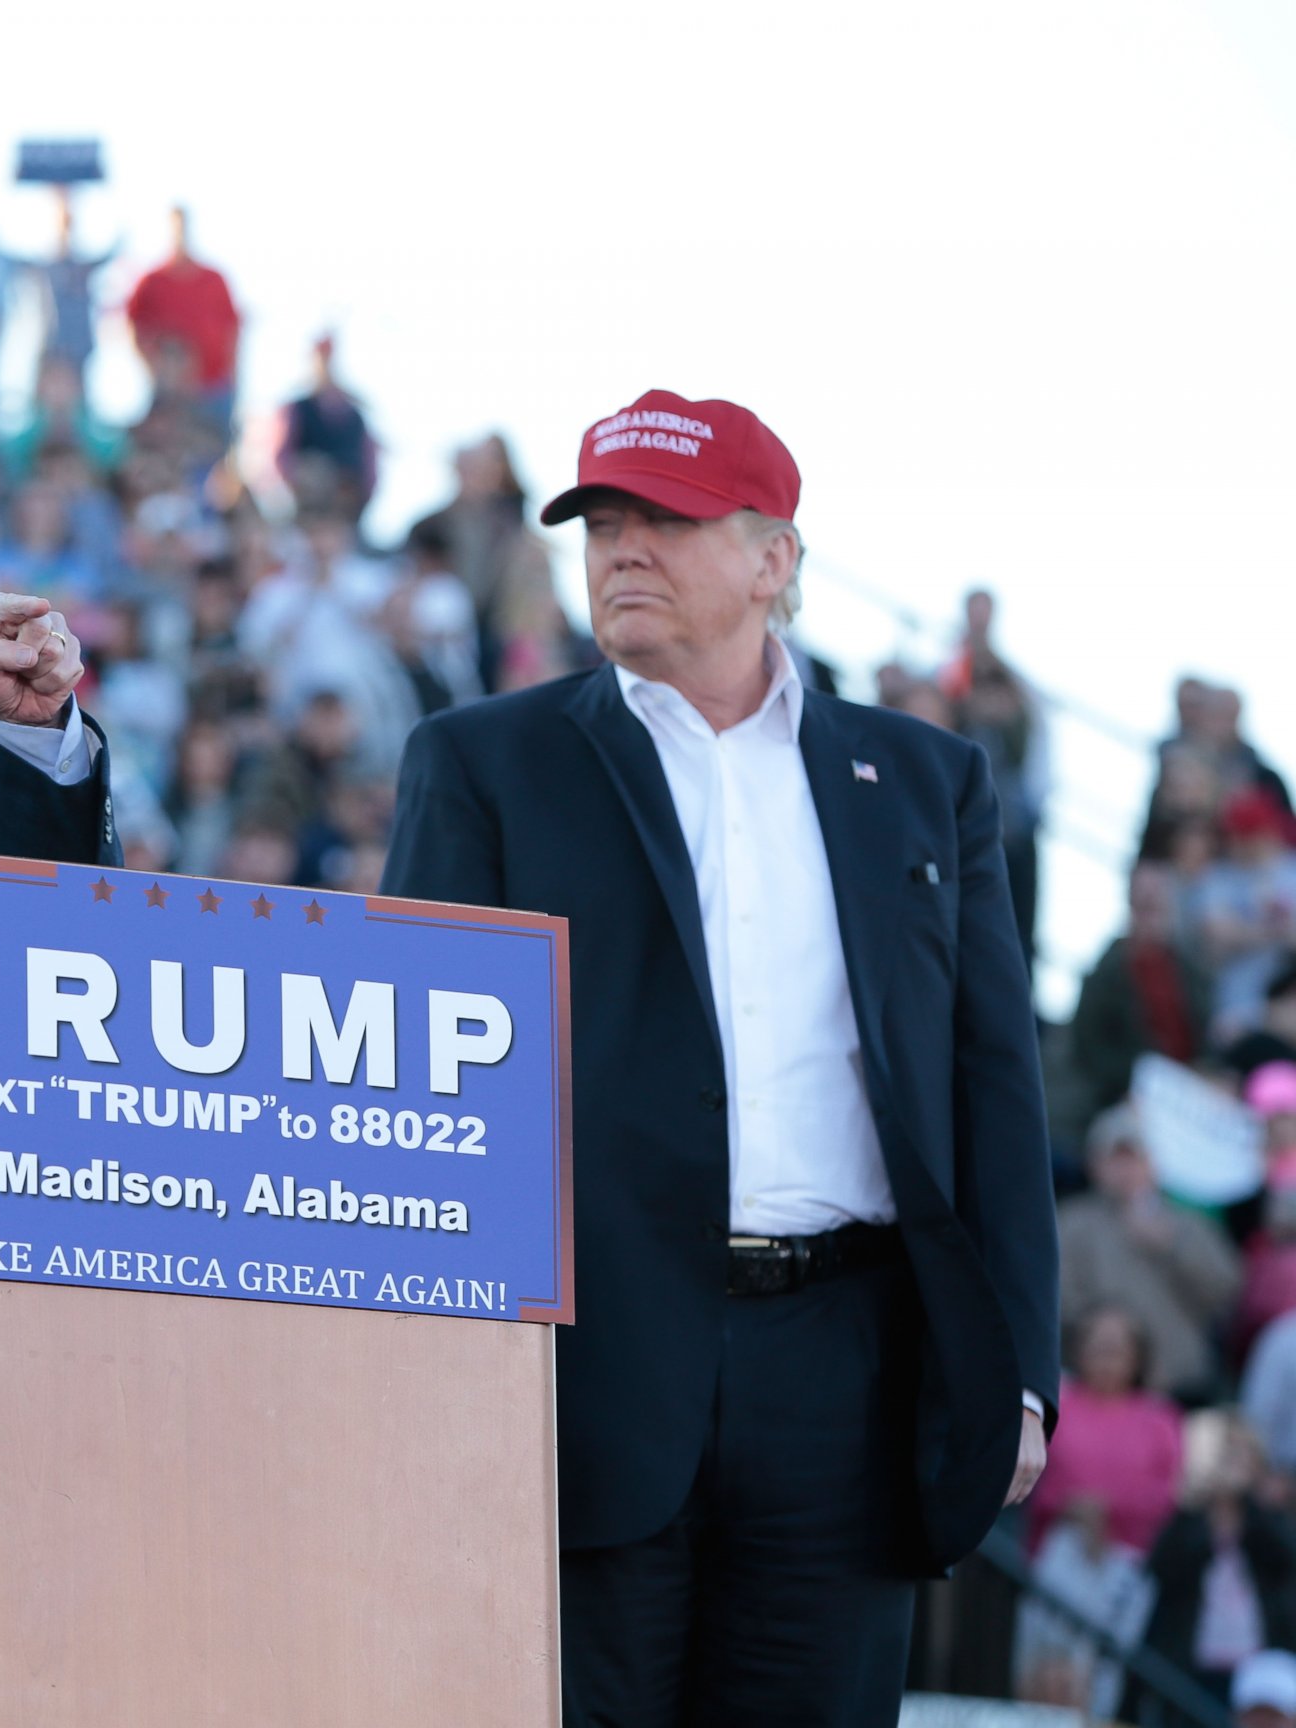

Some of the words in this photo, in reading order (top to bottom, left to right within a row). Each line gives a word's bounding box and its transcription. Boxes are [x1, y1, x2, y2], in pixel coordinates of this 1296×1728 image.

[631, 410, 714, 440] AMERICA
[638, 431, 701, 458] AGAIN
[278, 1105, 317, 1140] to
[329, 1104, 487, 1156] 88022
[243, 1173, 470, 1232] Alabama
[43, 1245, 228, 1289] AMERICA
[238, 1261, 365, 1299] GREAT
[374, 1273, 507, 1311] AGAIN!
